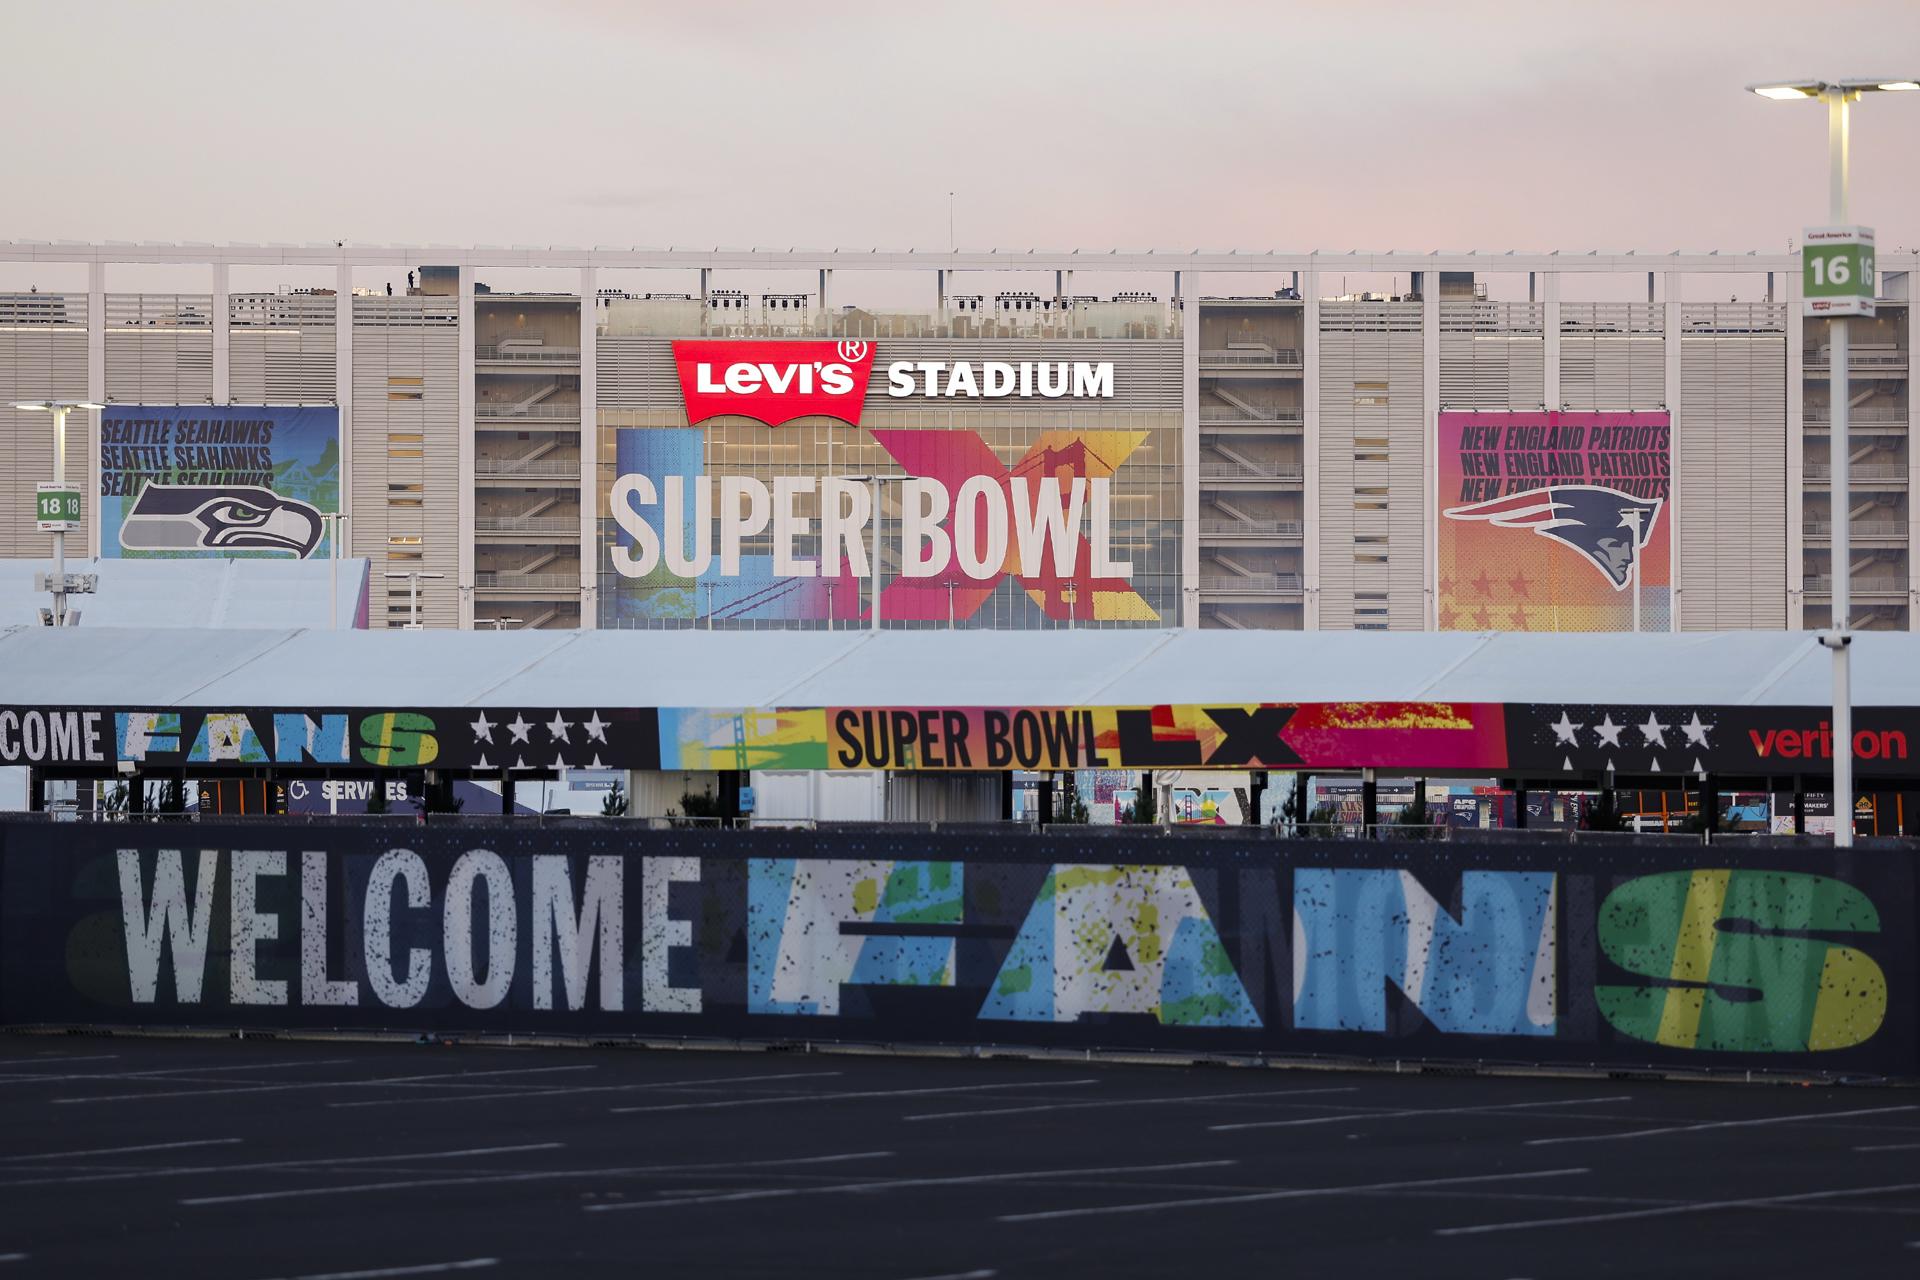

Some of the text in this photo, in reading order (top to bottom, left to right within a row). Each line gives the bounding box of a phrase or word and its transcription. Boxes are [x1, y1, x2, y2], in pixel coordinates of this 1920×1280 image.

[1810, 255, 1850, 286] 16
[1859, 256, 1874, 287] 16
[887, 361, 1114, 398] STADIUM
[101, 419, 275, 445] SEATTLE SEAHAWKS
[1460, 426, 1671, 450] NEW ENGLAND PATRIOTS
[101, 446, 273, 471] SEATTLE SEAHAWKS
[1460, 452, 1671, 476] NEW ENGLAND PATRIOTS
[1460, 478, 1503, 502] NEW
[41, 498, 61, 515] 18
[66, 498, 79, 515] 18
[610, 474, 1134, 580] SUPER BOWL
[114, 712, 439, 767] FANS
[836, 706, 1308, 769] SUPER BOWL LX
[1749, 721, 1908, 760] verion
[321, 780, 408, 801] SERVIES
[116, 848, 1888, 1054] WELCOME FANS
